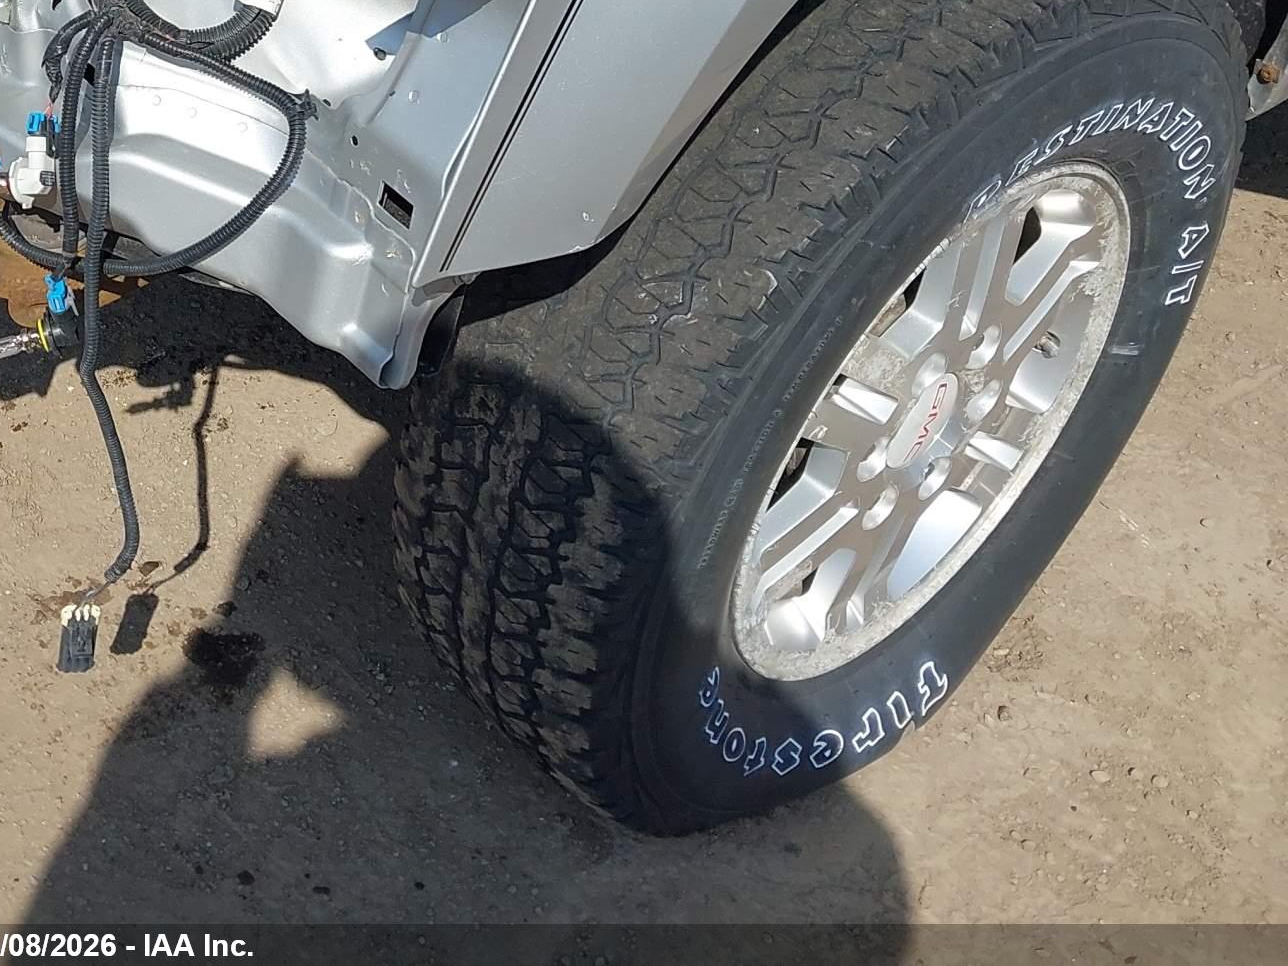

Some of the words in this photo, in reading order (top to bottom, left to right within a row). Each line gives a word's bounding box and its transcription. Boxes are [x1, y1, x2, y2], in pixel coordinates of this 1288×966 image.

[963, 97, 1216, 224] DESTINATION
[1165, 223, 1210, 306] A/T
[903, 382, 948, 463] GMC
